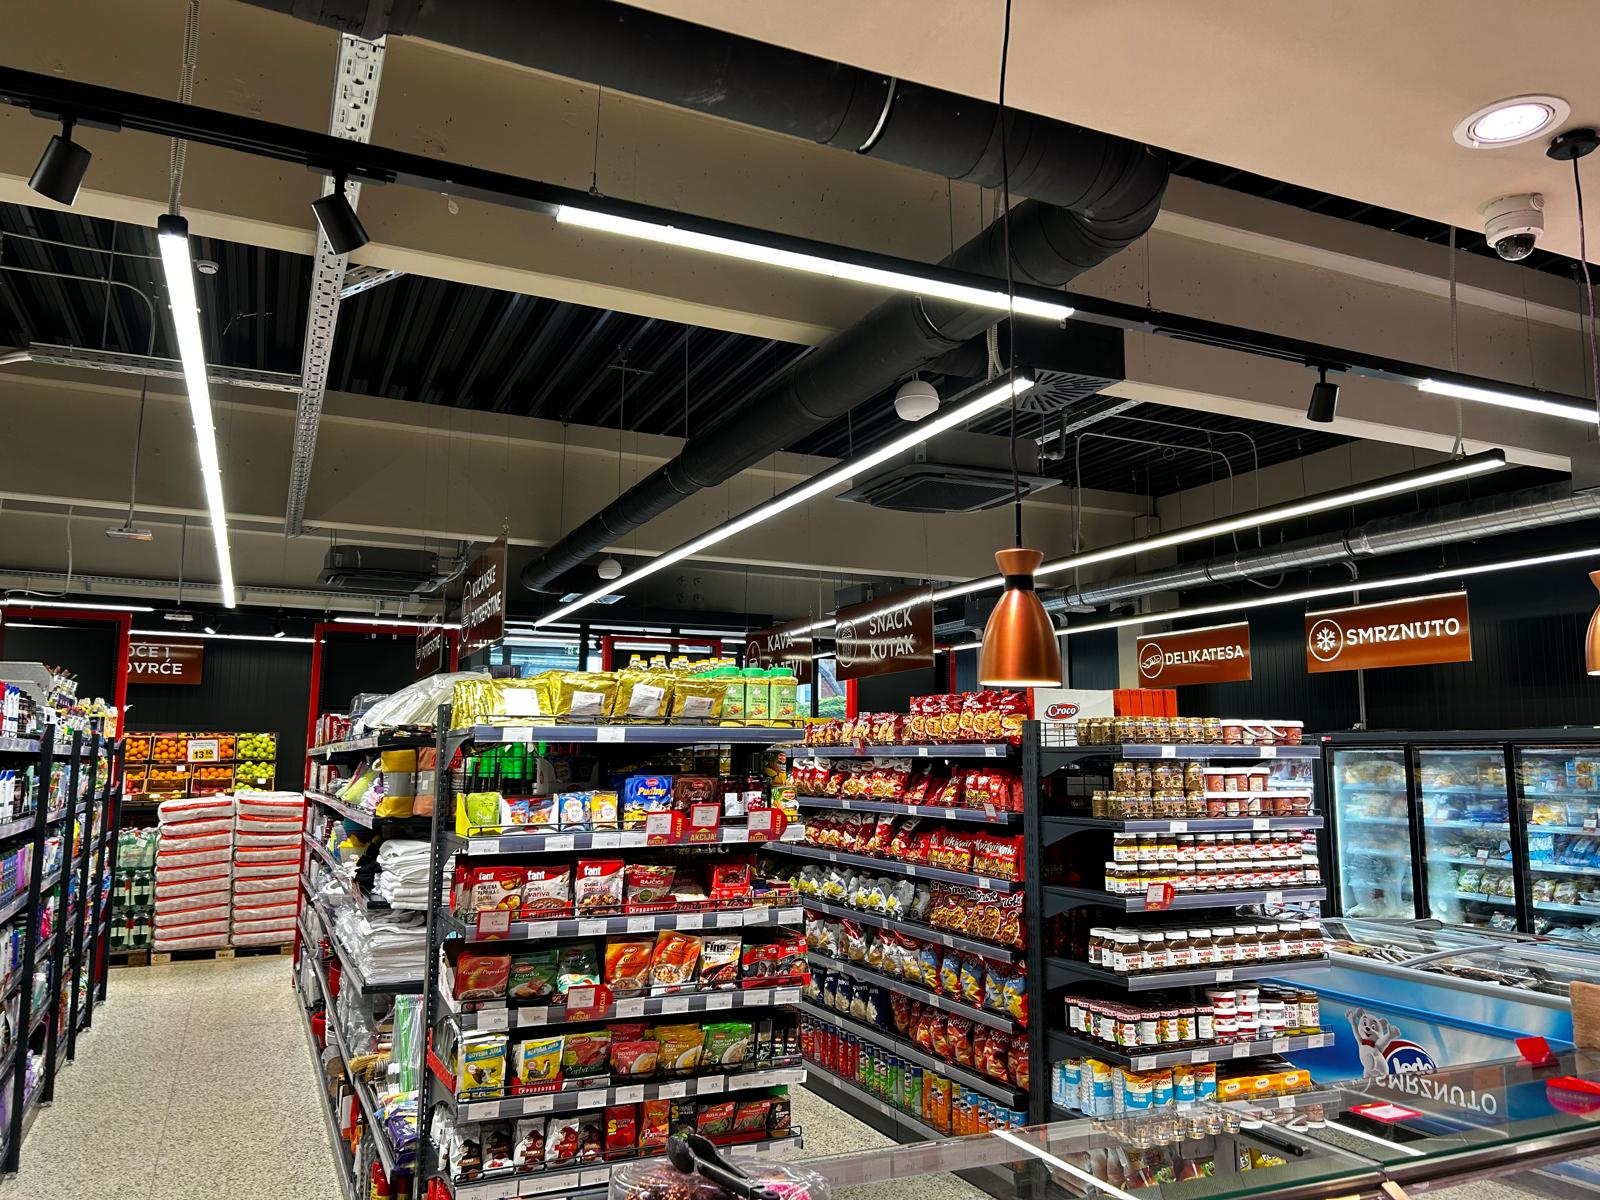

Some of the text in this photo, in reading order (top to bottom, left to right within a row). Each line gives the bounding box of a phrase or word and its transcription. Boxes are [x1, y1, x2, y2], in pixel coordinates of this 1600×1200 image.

[869, 607, 913, 635] SNACK
[1346, 618, 1460, 646] SMRZNUTO
[767, 632, 794, 652] KAVA
[869, 634, 914, 661] KUTAK
[1165, 645, 1245, 666] DELIKATESA
[1047, 705, 1076, 717] Croco
[194, 751, 204, 759] 13
[637, 786, 667, 798] Puding
[690, 833, 717, 842] AKCIJA!
[478, 872, 495, 881] fant
[527, 870, 545, 881] fant
[583, 866, 602, 876] fant
[704, 941, 726, 953] Fino
